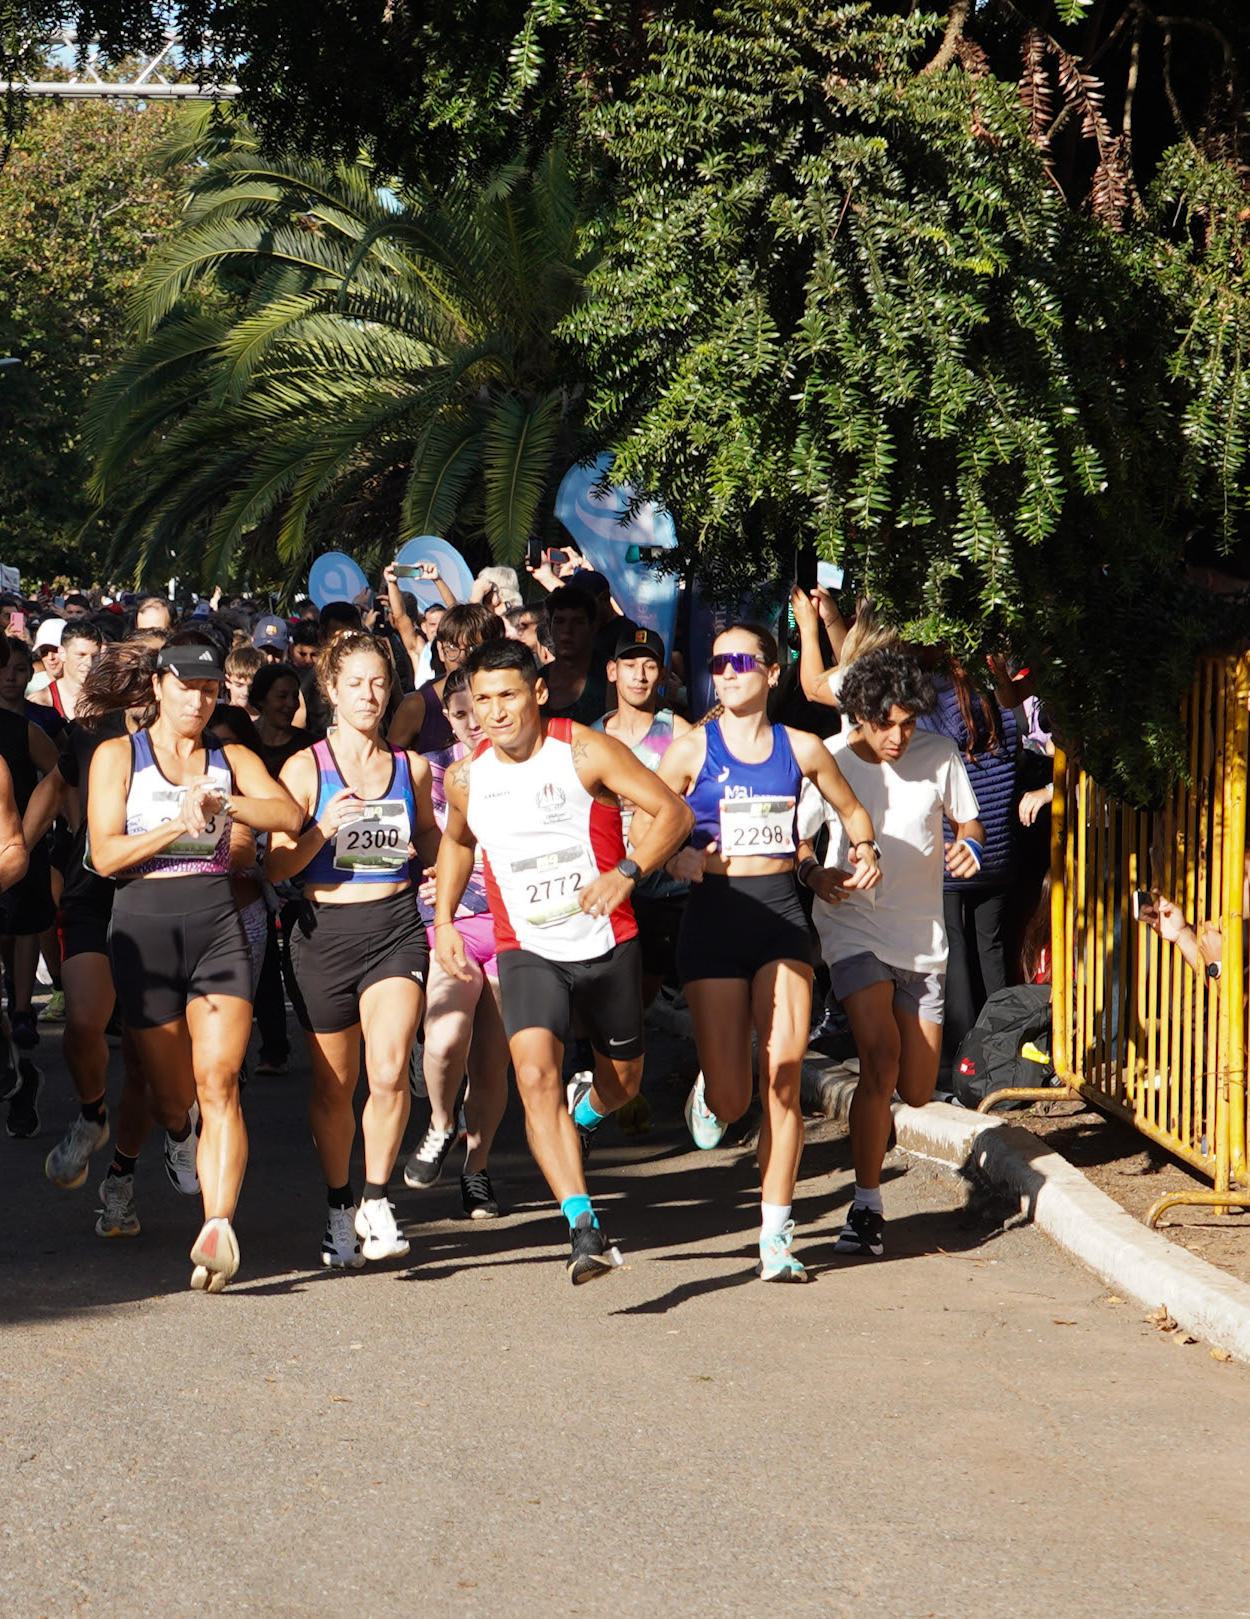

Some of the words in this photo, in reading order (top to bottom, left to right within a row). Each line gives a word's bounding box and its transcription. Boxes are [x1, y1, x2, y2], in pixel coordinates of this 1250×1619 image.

[346, 828, 398, 850] 2300
[733, 825, 783, 846] 2298
[526, 872, 584, 903] 2772
